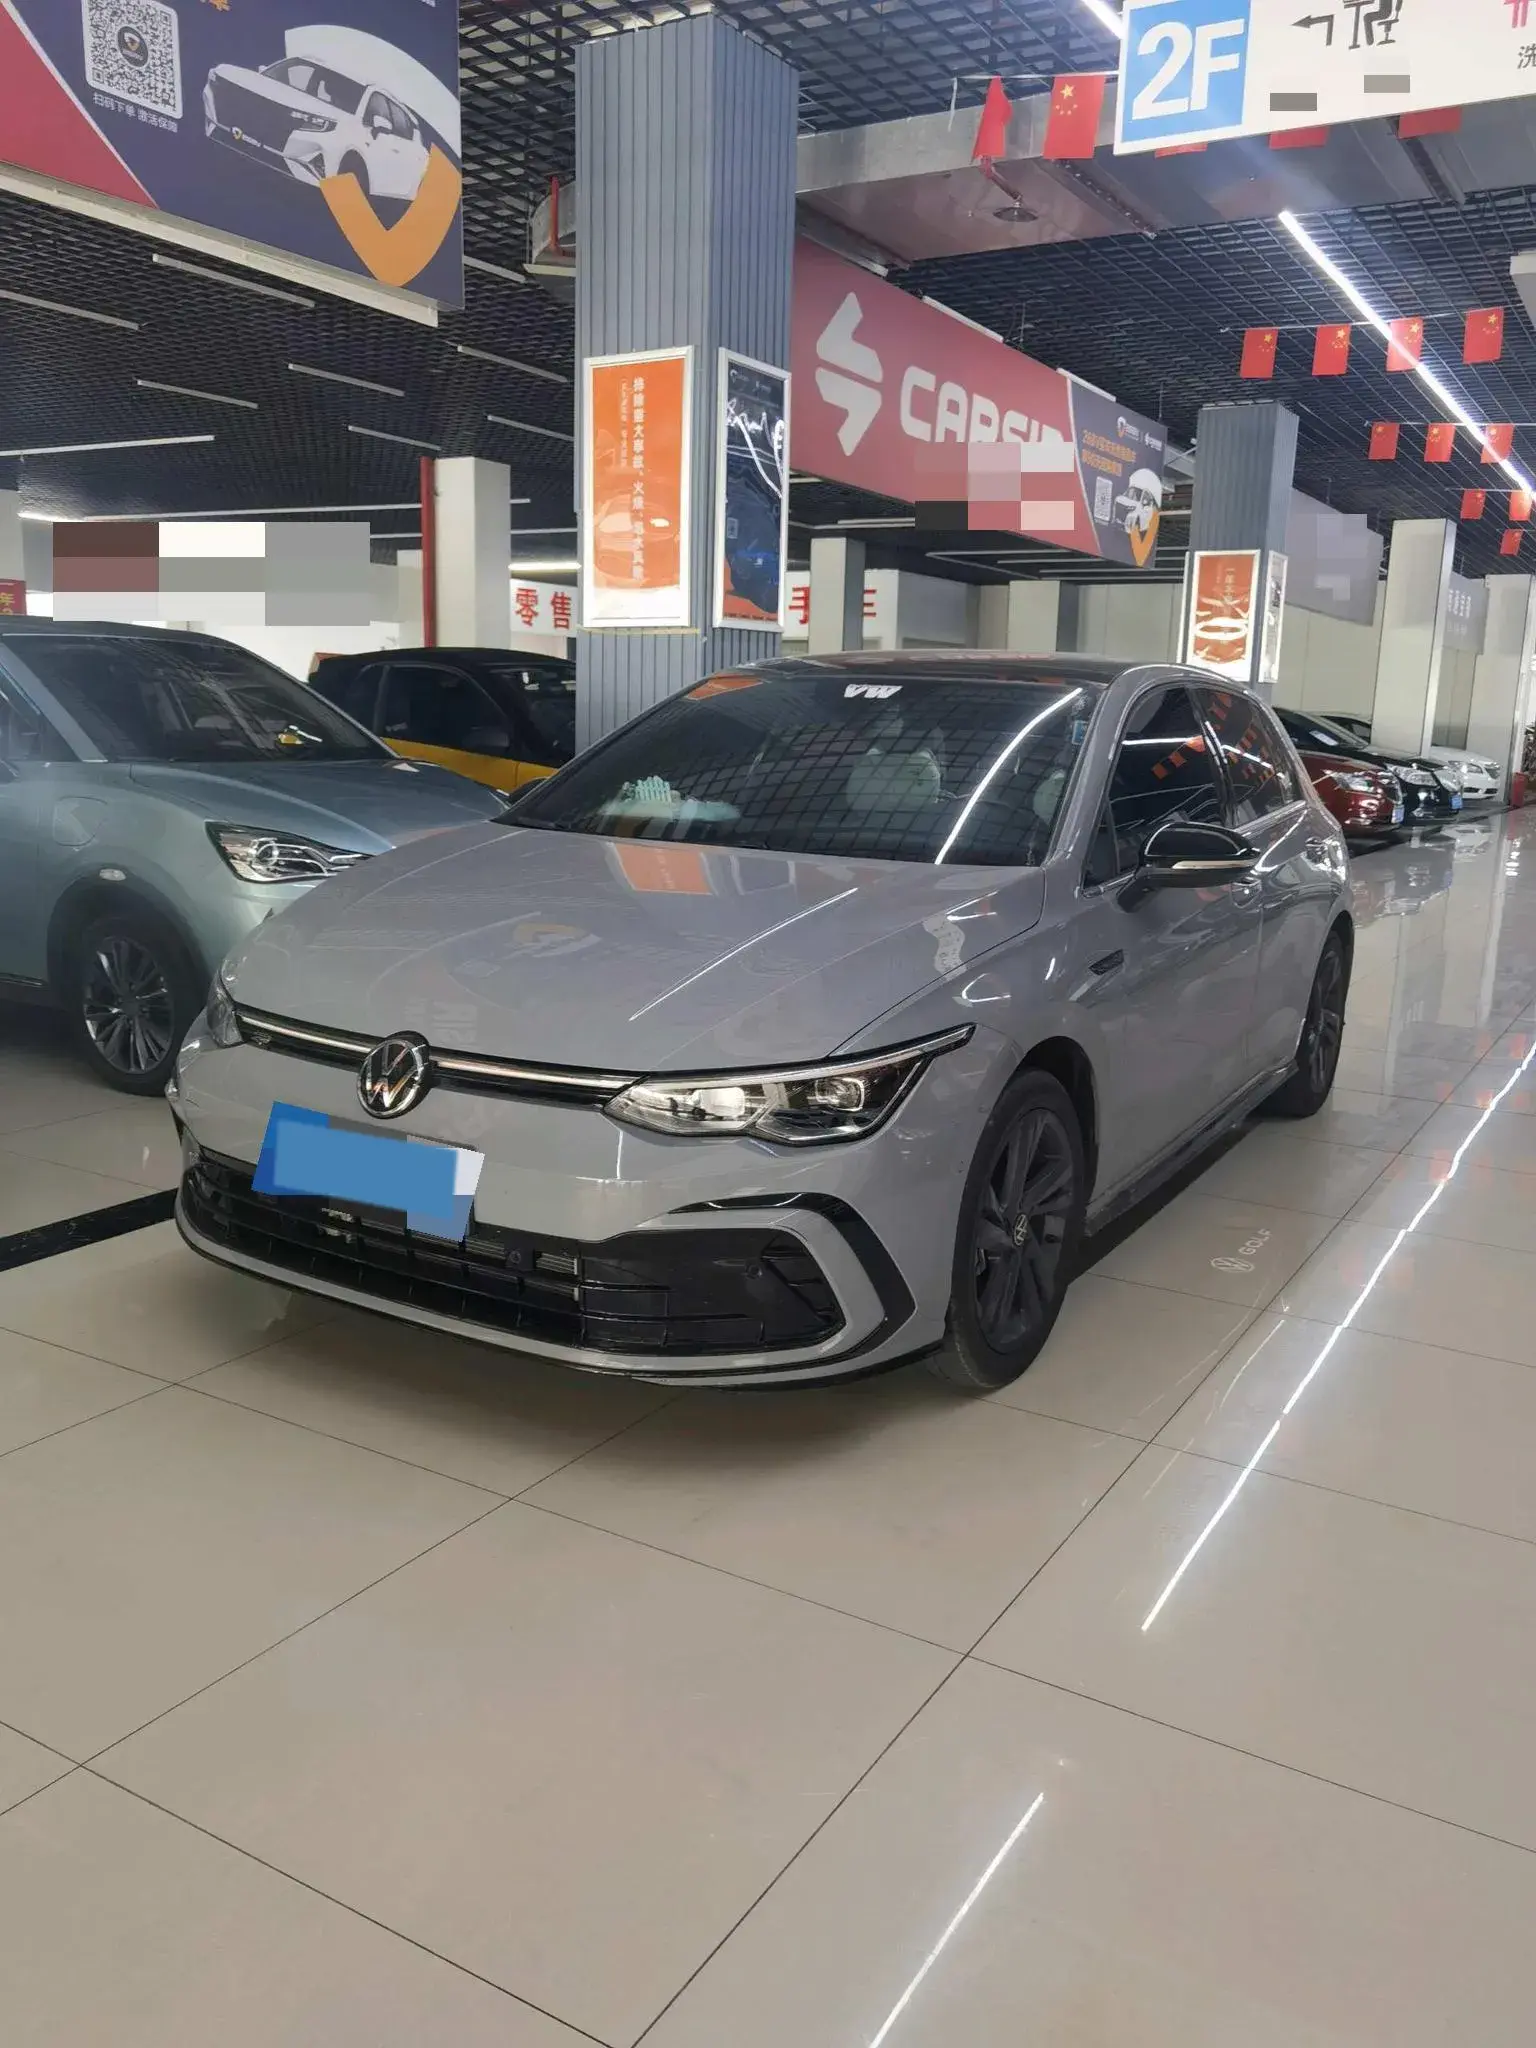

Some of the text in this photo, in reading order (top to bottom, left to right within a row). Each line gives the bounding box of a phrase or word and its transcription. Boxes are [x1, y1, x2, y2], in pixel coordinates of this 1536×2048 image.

[1131, 18, 1245, 121] 2F
[514, 586, 572, 630] 零售
[843, 683, 904, 699] VW
